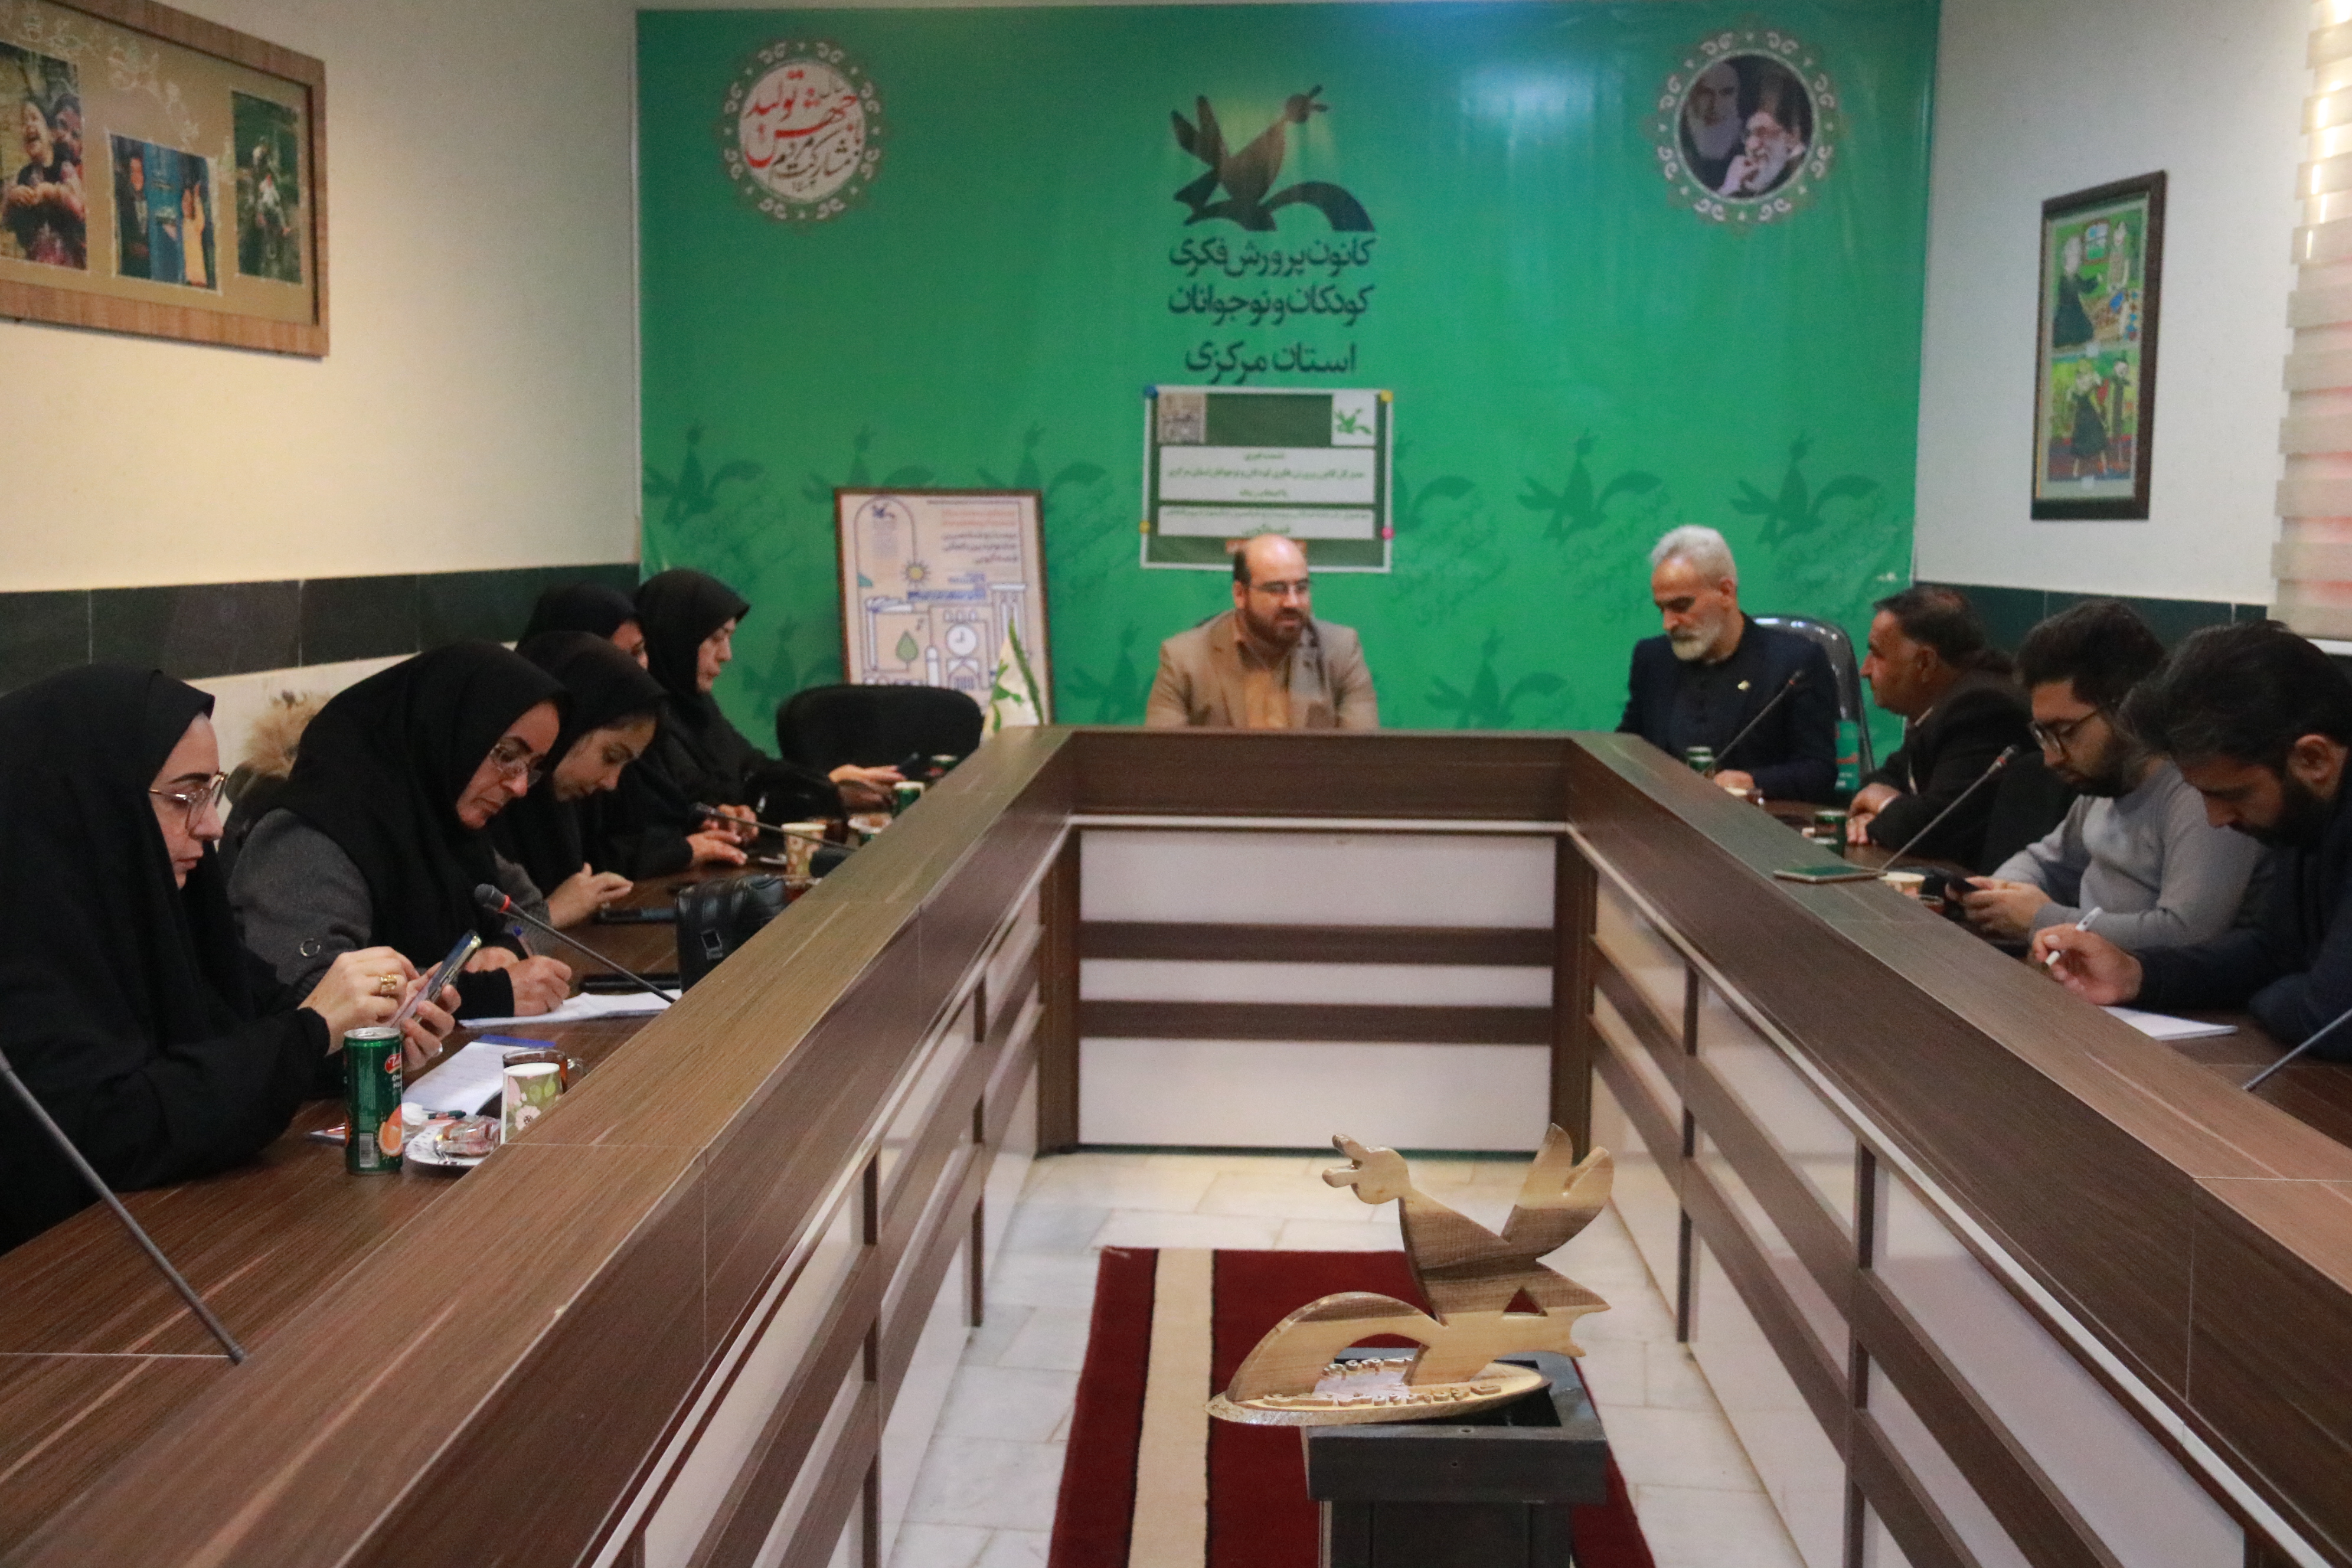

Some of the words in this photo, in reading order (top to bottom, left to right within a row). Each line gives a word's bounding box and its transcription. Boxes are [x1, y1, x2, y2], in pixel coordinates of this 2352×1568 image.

[1169, 236, 1229, 278] فکری
[1224, 239, 1306, 277] پرورش
[1306, 235, 1377, 277] کانون
[1168, 282, 1270, 327] نوجوانان
[1286, 281, 1376, 327] کودکان
[1184, 339, 1268, 385] مرکزی
[1272, 341, 1357, 373] استان
